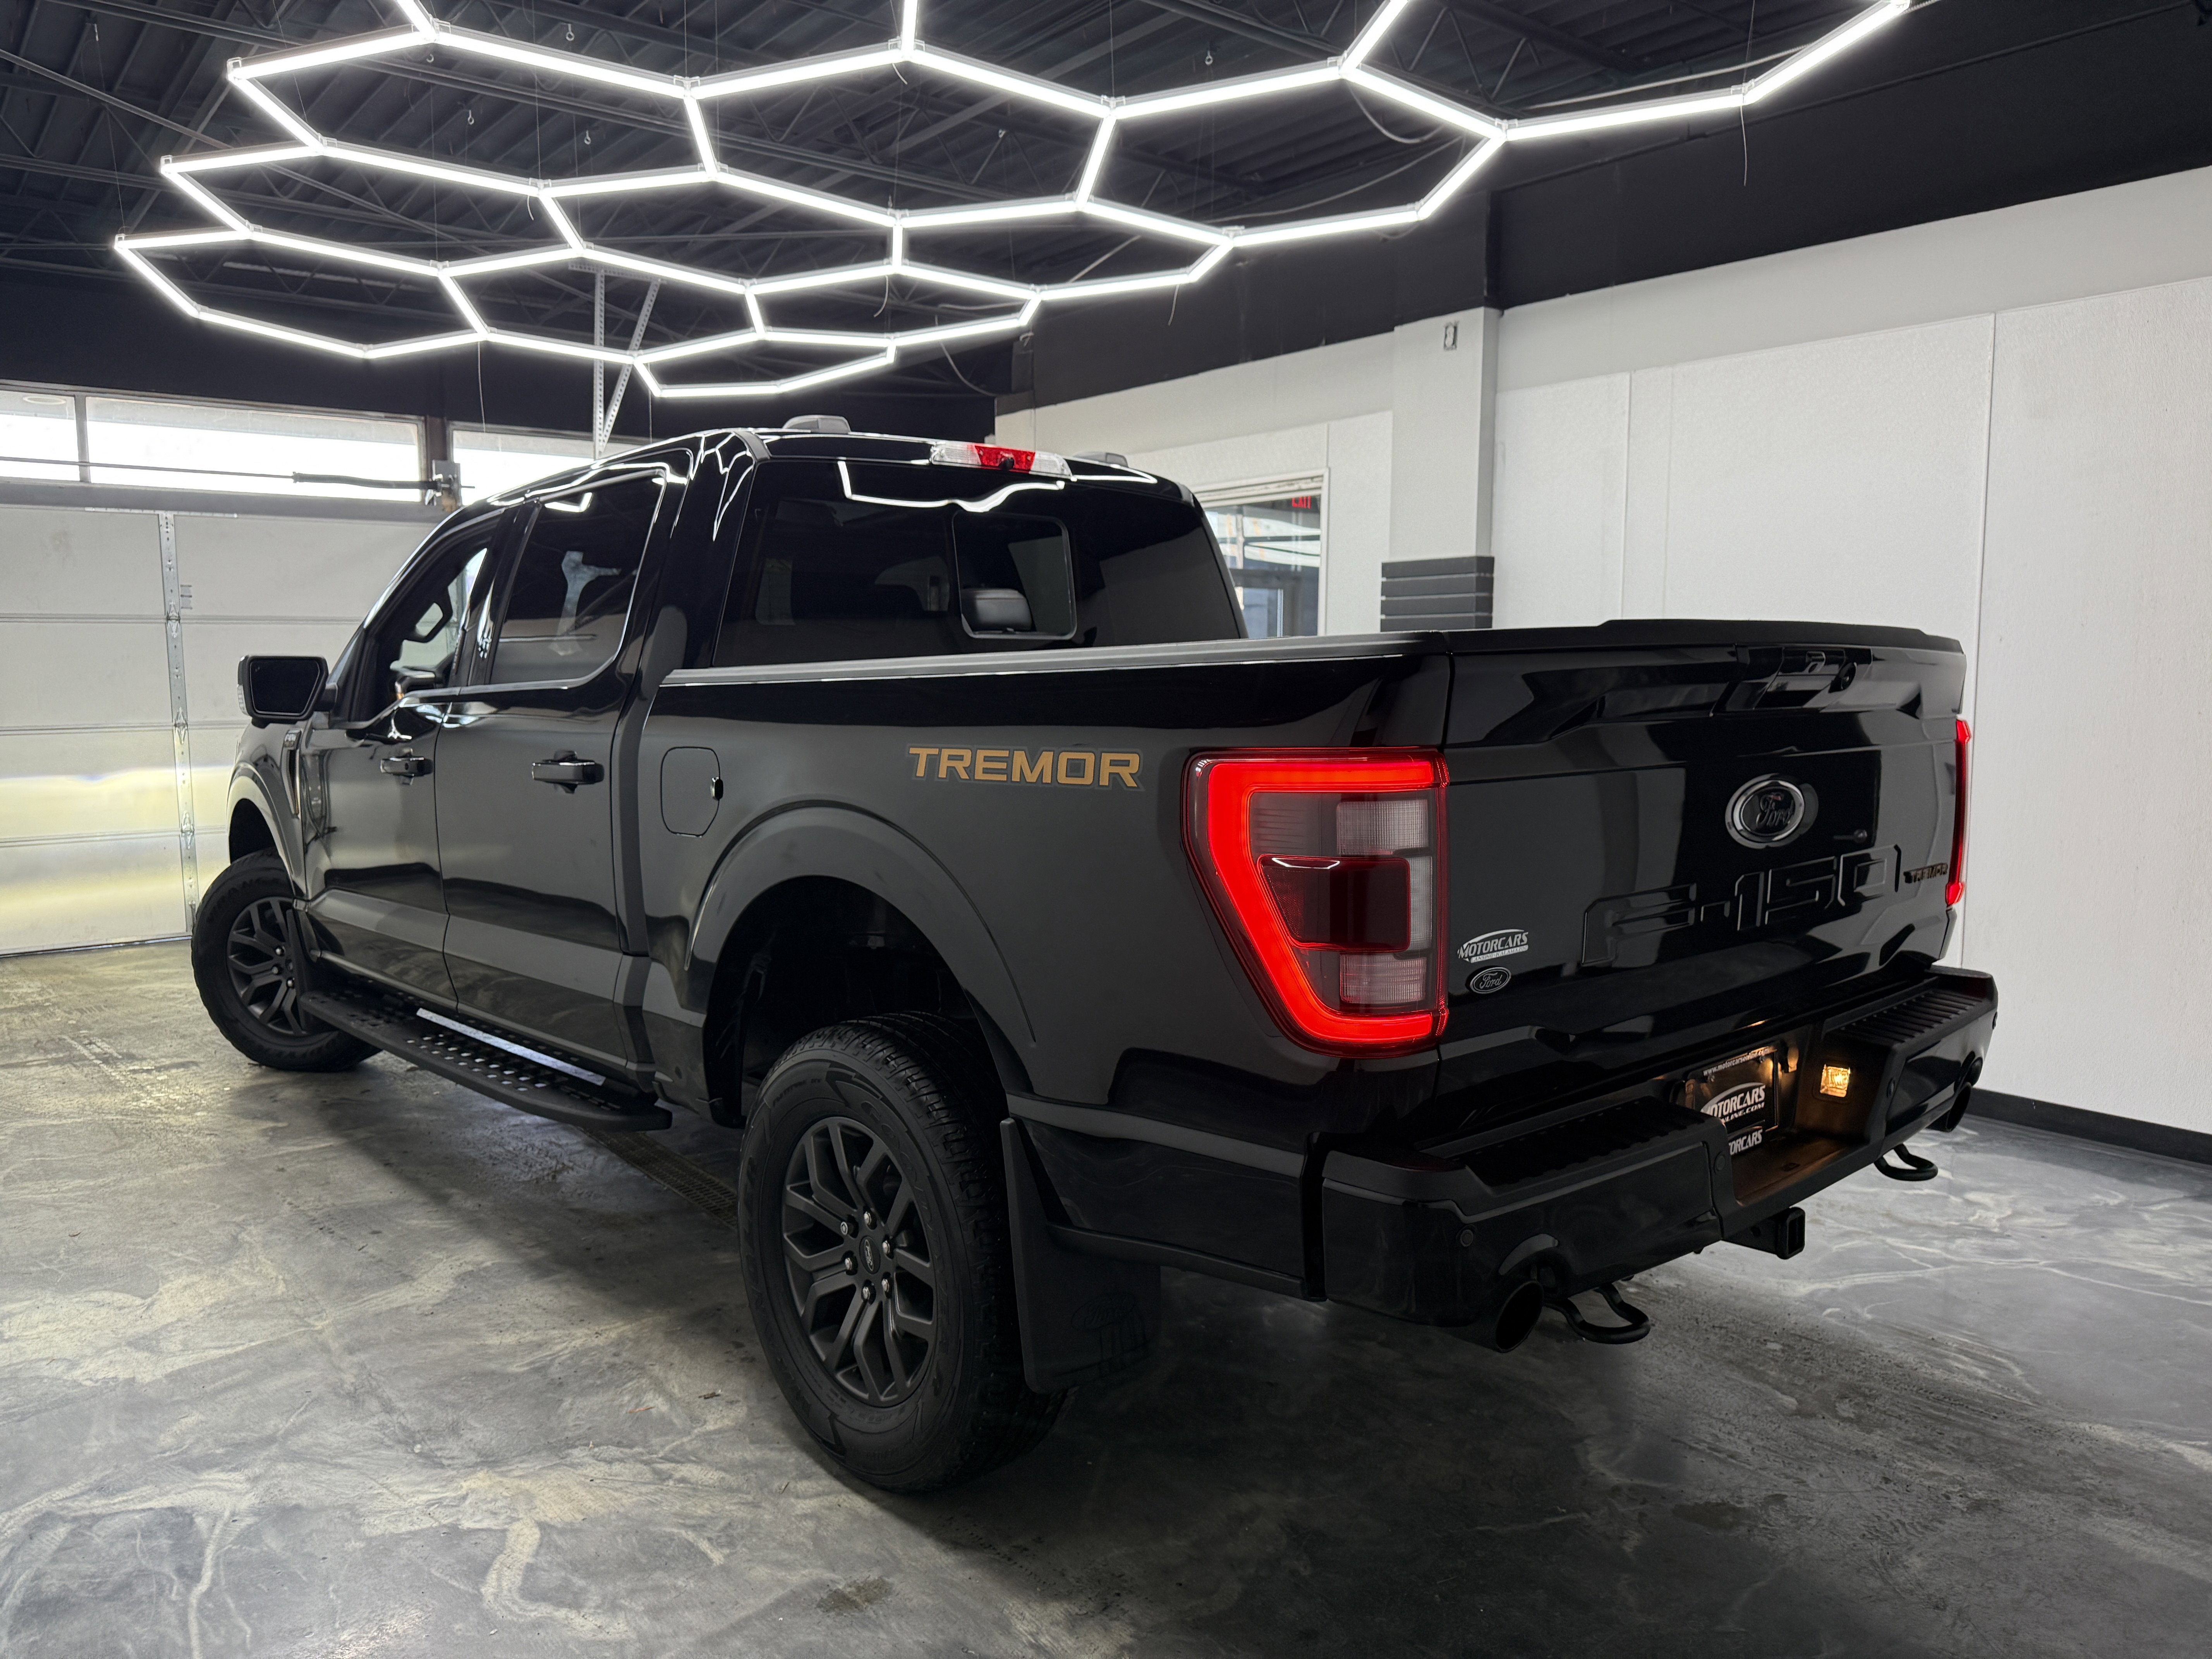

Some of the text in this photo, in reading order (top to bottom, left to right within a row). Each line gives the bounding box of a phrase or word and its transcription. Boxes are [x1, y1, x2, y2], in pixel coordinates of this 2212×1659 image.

[909, 747, 1140, 787] TREMOR
[1756, 792, 1794, 828] Ford
[1458, 931, 1529, 959] MOTORCARS
[1479, 972, 1503, 989] Ford
